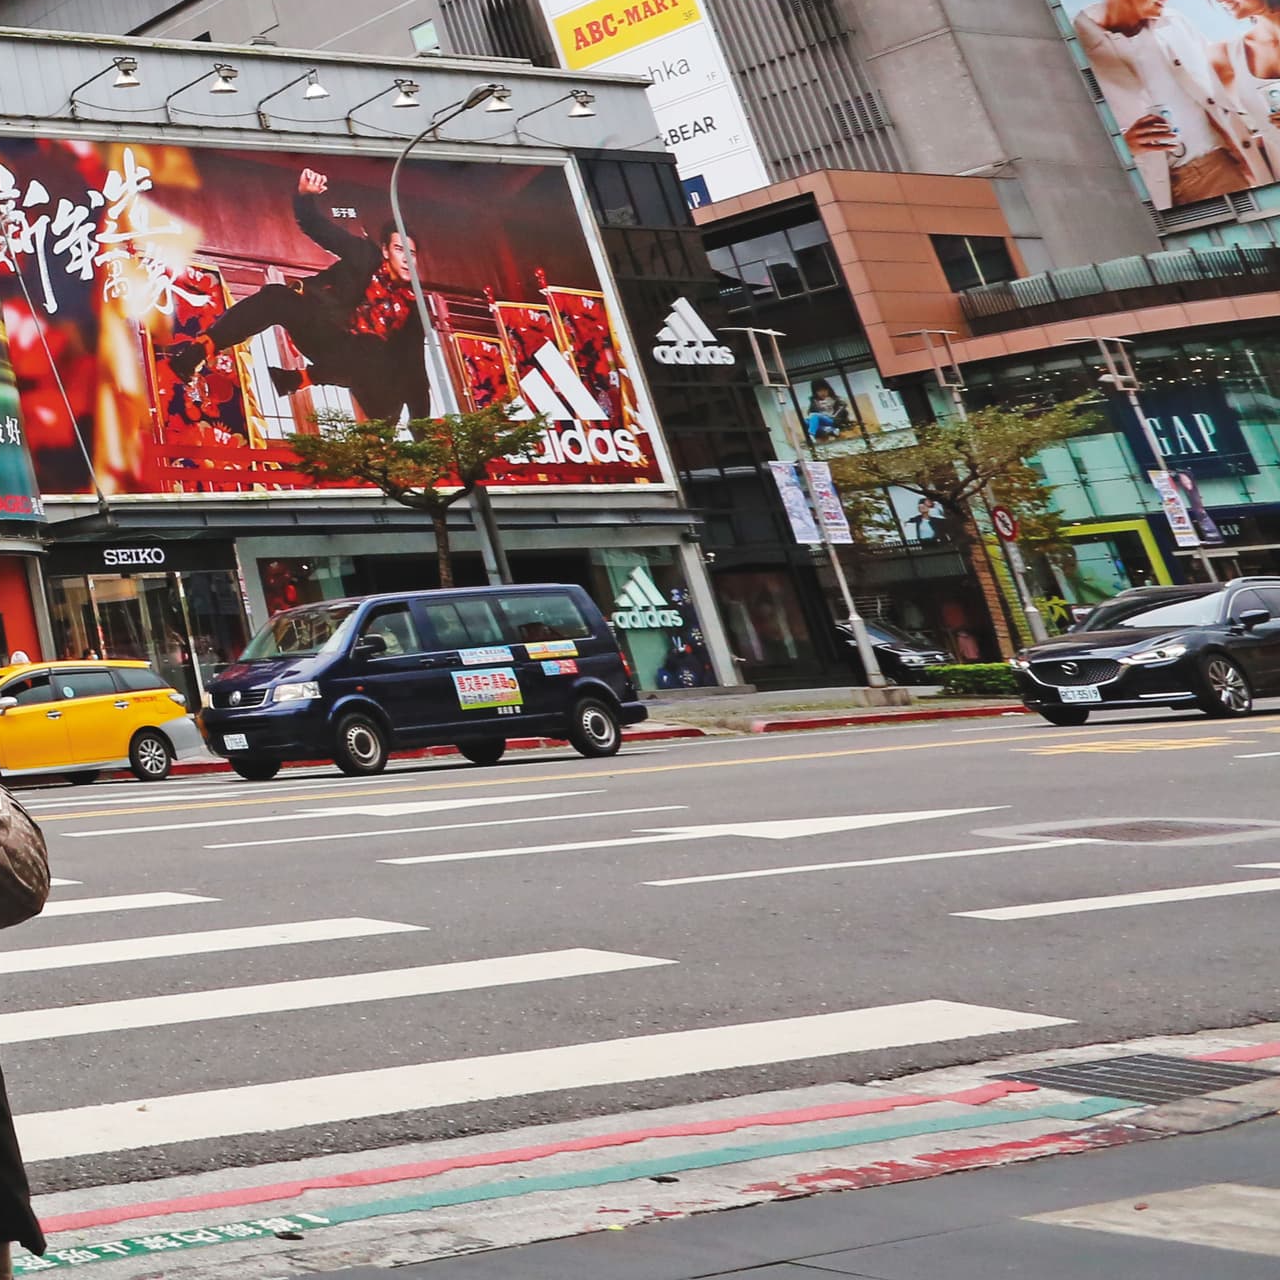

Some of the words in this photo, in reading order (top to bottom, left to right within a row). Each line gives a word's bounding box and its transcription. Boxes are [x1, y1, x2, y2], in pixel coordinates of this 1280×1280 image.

[652, 340, 736, 366] adidas
[1146, 412, 1220, 457] GAP
[1219, 524, 1240, 536] GAP
[103, 547, 165, 566] SEIKO
[611, 604, 683, 629] adidas
